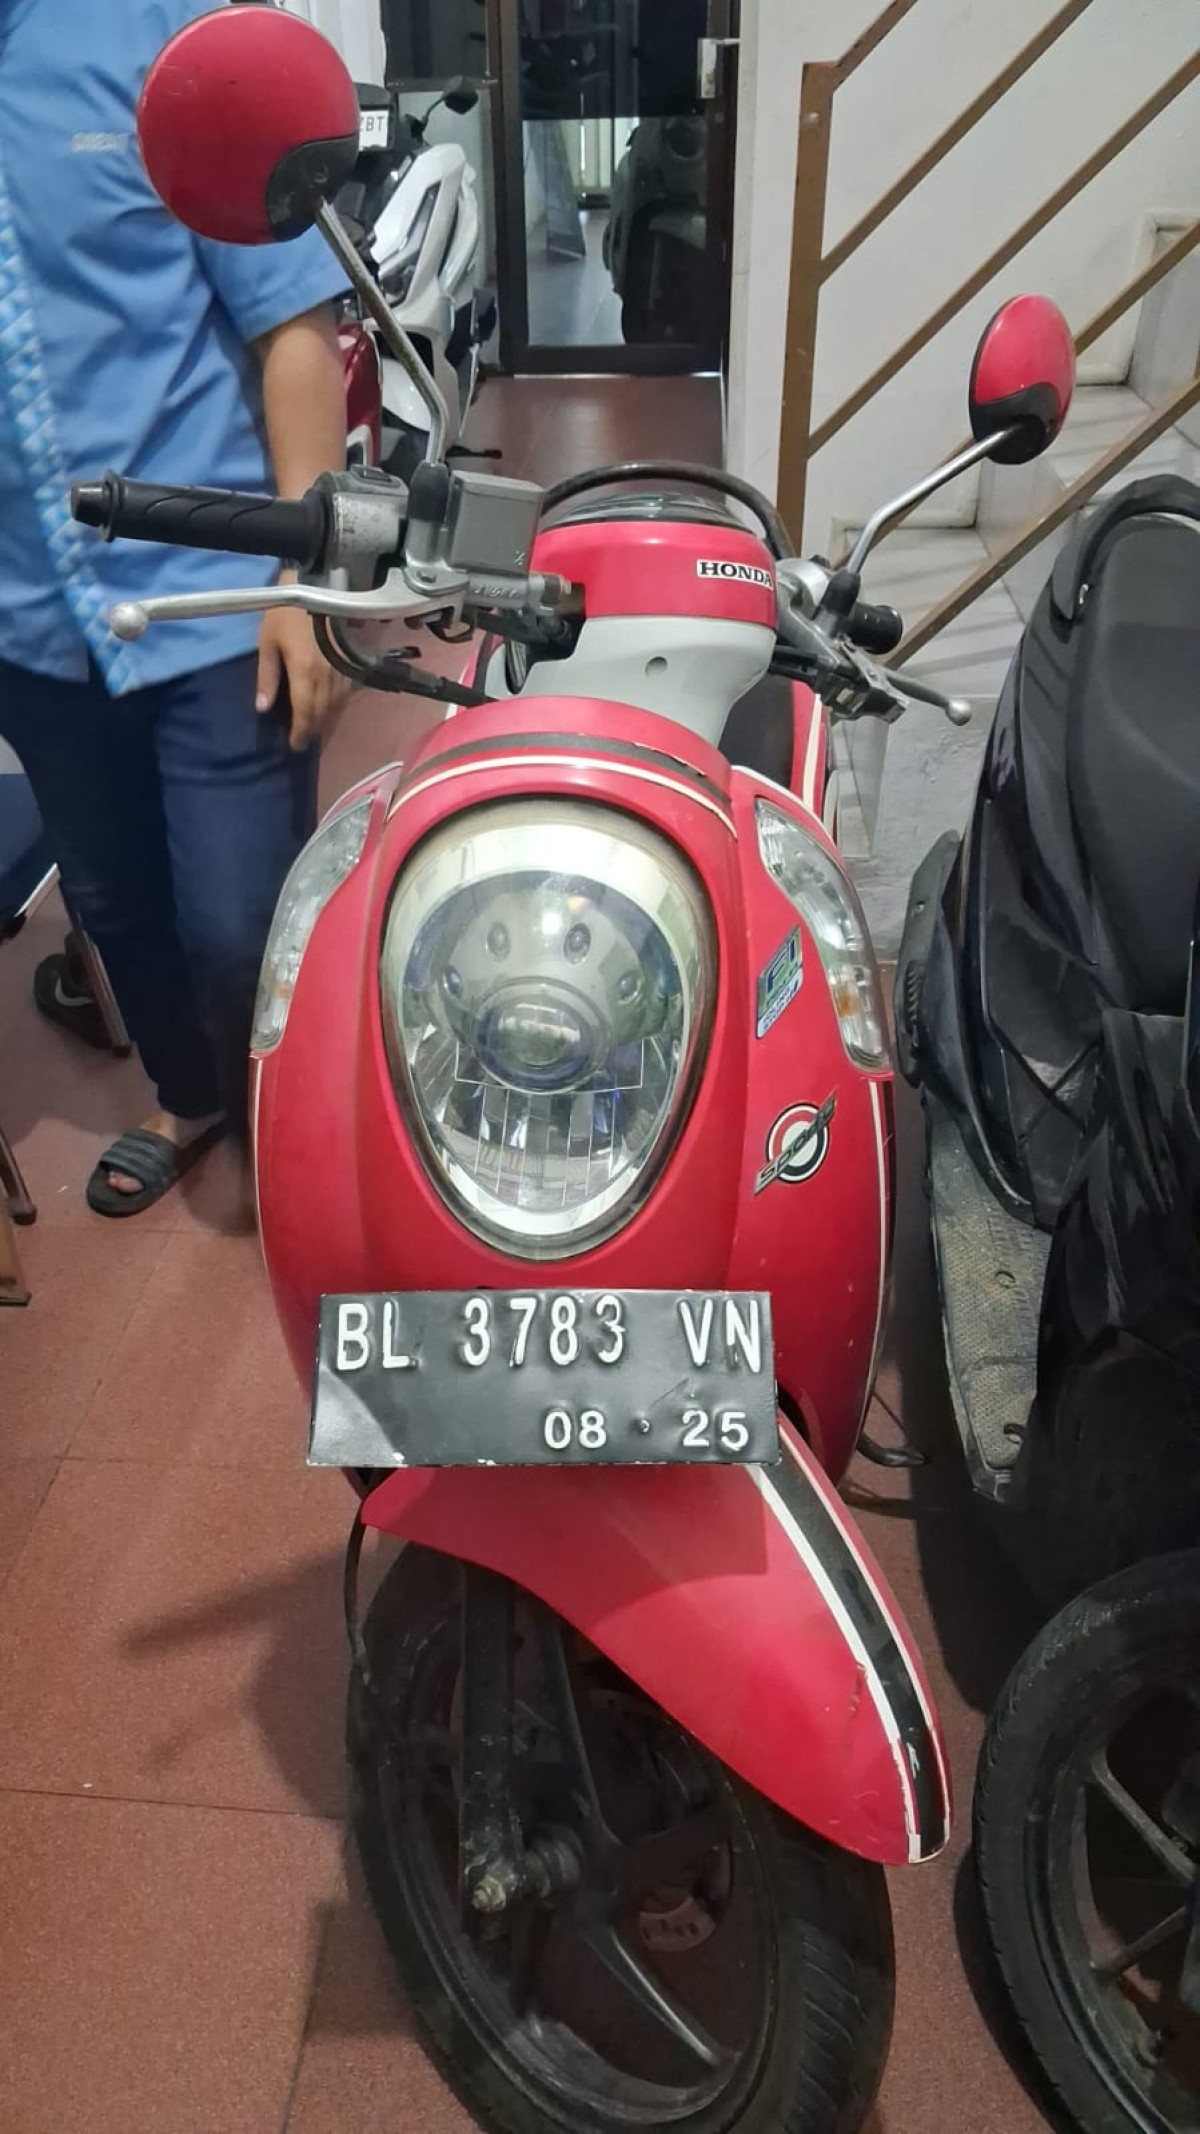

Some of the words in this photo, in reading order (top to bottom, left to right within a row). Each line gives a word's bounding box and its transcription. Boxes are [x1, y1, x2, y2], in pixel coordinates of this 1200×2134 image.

[701, 561, 771, 587] HONDA
[337, 1302, 410, 1370] BL
[460, 1294, 627, 1367] 3783
[679, 1299, 761, 1372] VN
[543, 1409, 607, 1449] 08
[682, 1408, 749, 1452] 25
